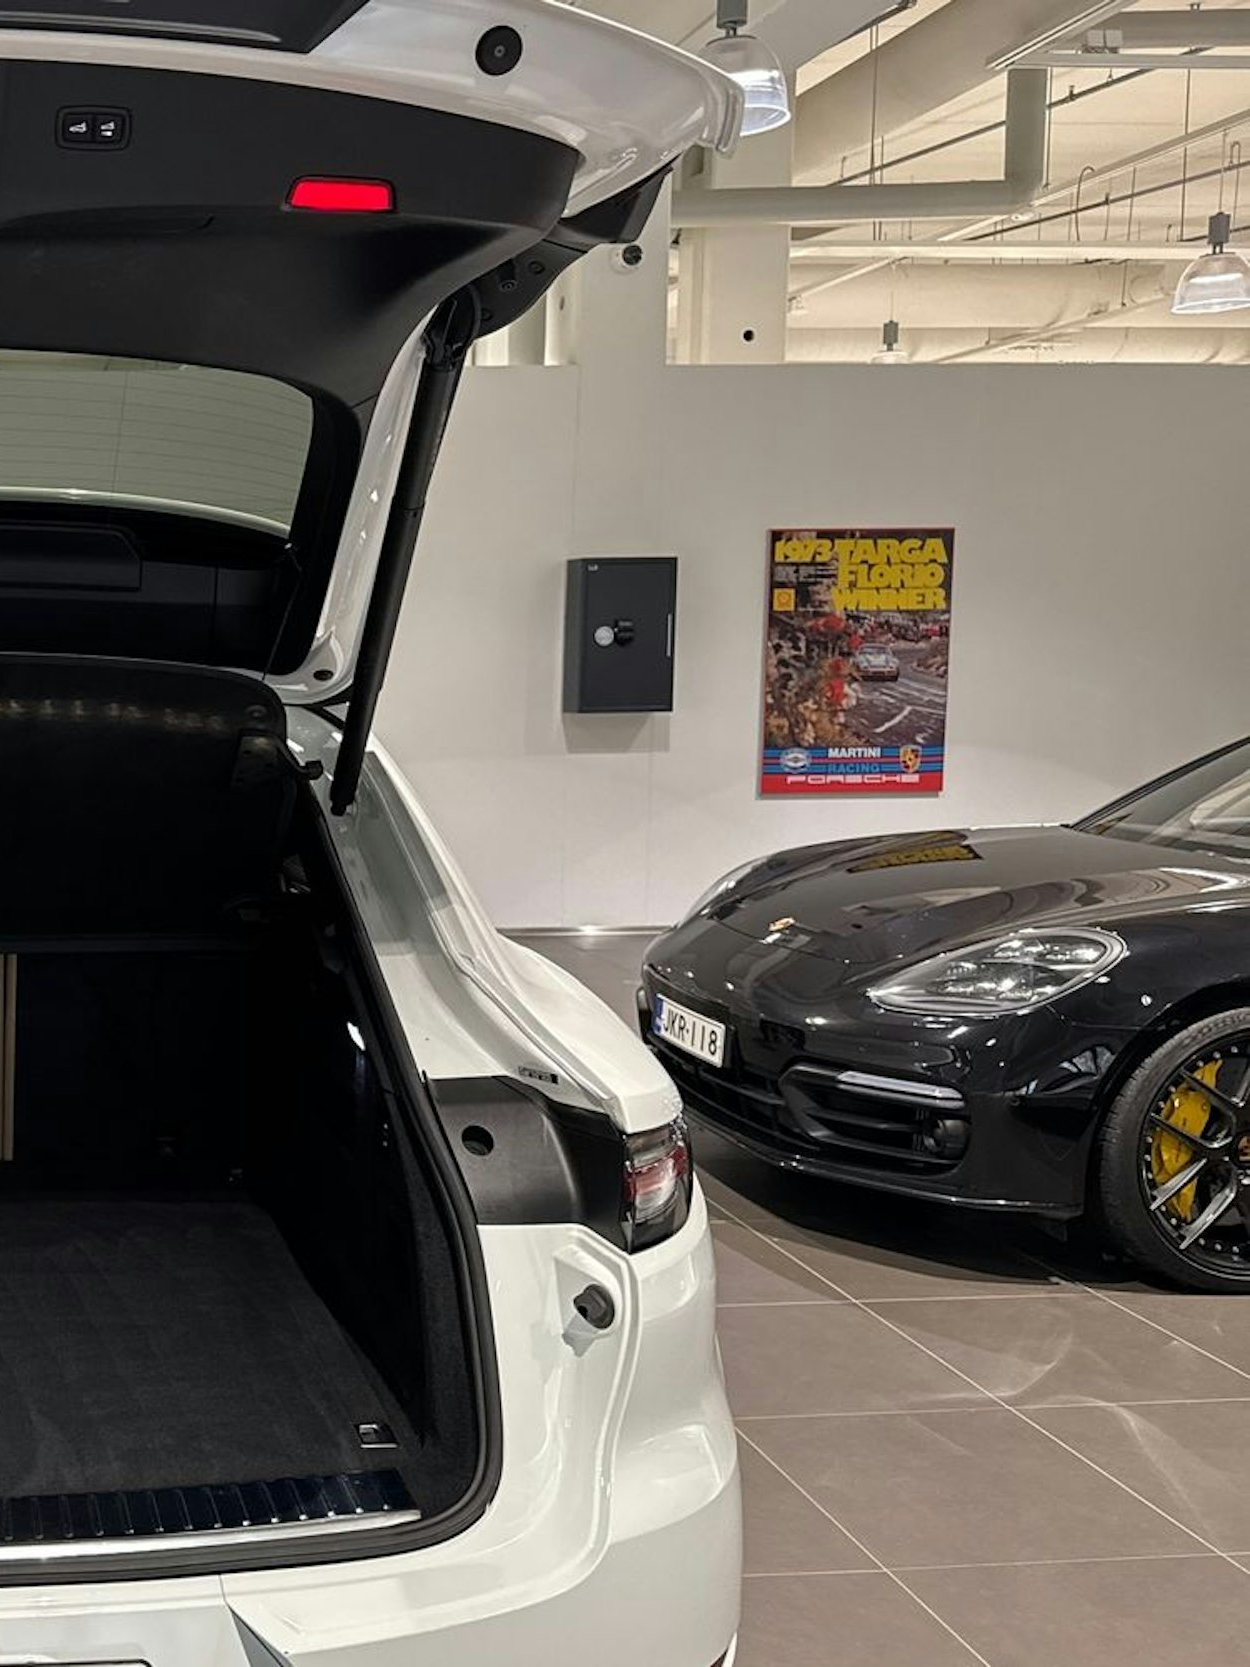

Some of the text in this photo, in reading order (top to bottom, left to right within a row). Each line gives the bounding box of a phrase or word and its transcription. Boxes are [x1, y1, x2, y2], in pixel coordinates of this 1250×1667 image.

[775, 539, 948, 564] 1973 TARGA
[838, 563, 945, 588] FLORIO
[832, 588, 946, 611] WINNER
[828, 747, 881, 758] MARTINI
[786, 774, 920, 785] PORSCHE
[828, 763, 880, 774] RACING
[663, 1009, 718, 1055] JKR-118
